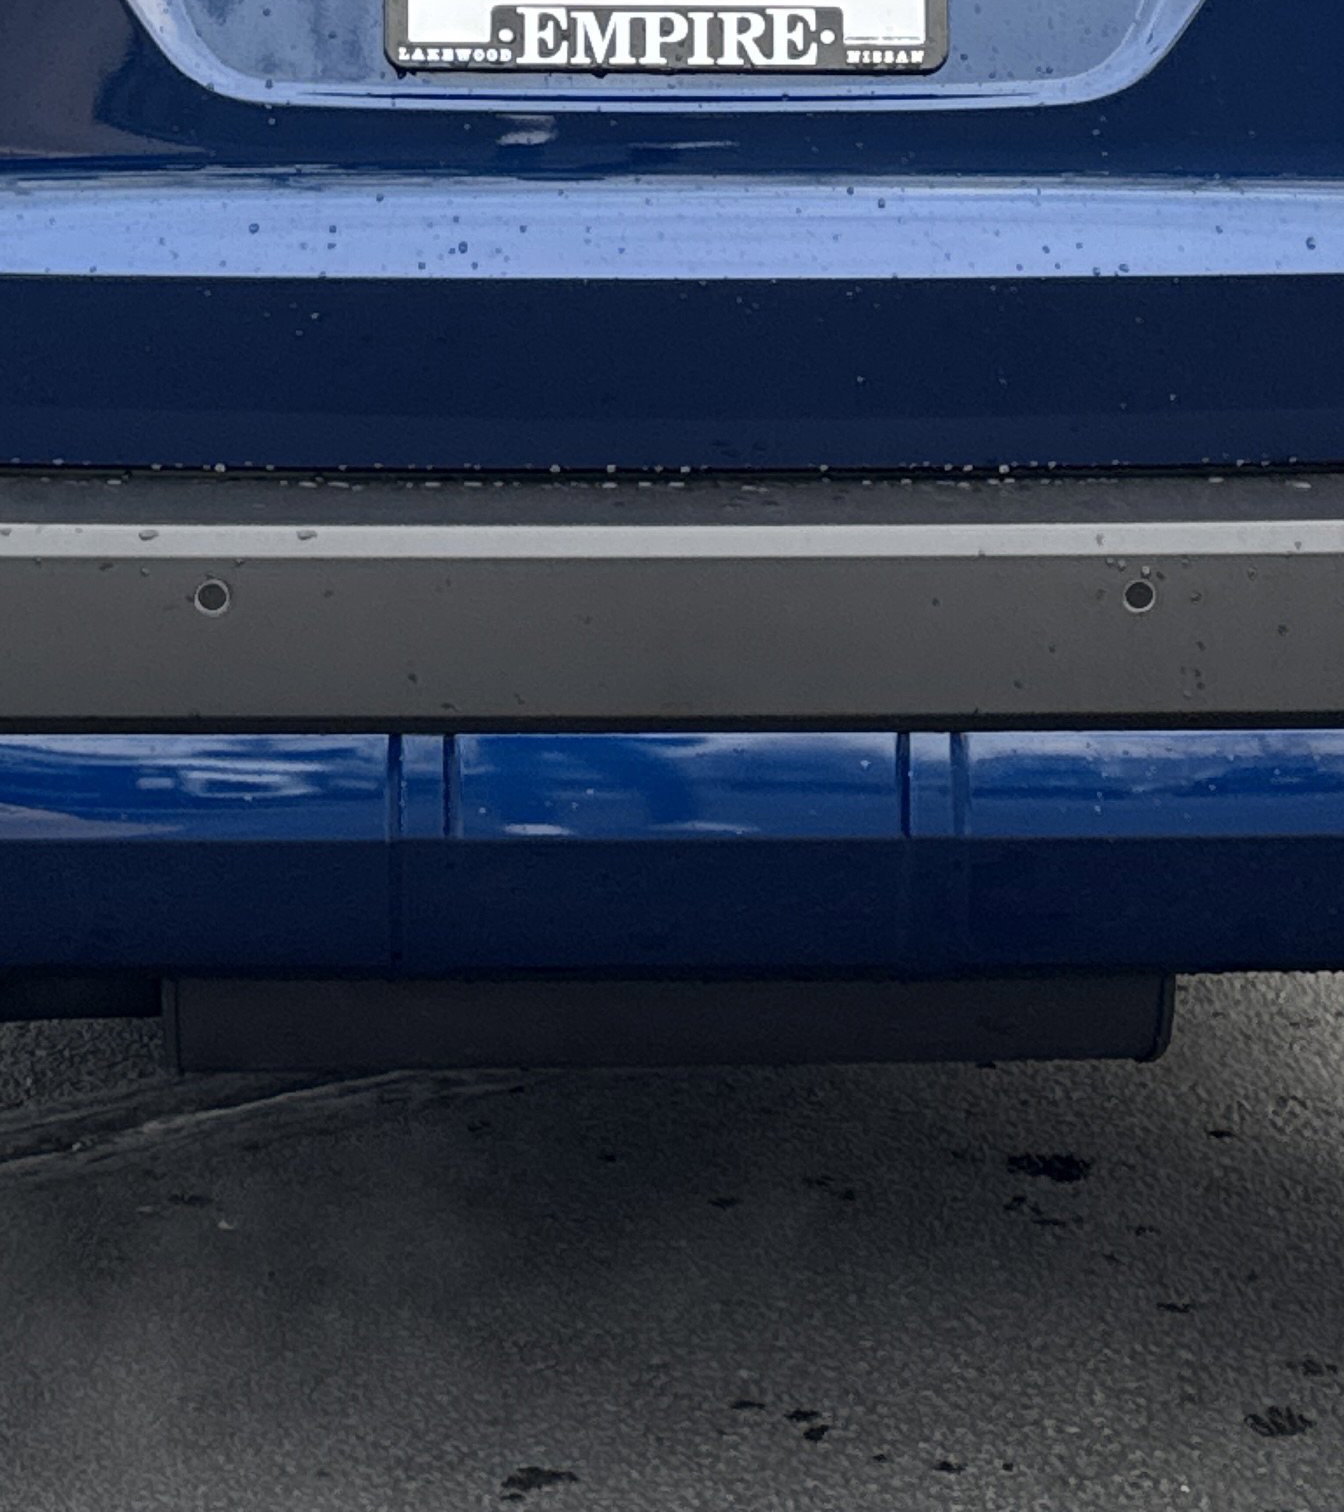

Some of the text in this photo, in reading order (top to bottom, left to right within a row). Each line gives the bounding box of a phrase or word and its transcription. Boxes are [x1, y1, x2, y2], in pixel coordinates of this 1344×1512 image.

[516, 6, 817, 66] EMPIRE
[398, 47, 512, 62] LAKEWOOD
[846, 50, 924, 64] NISSAN
